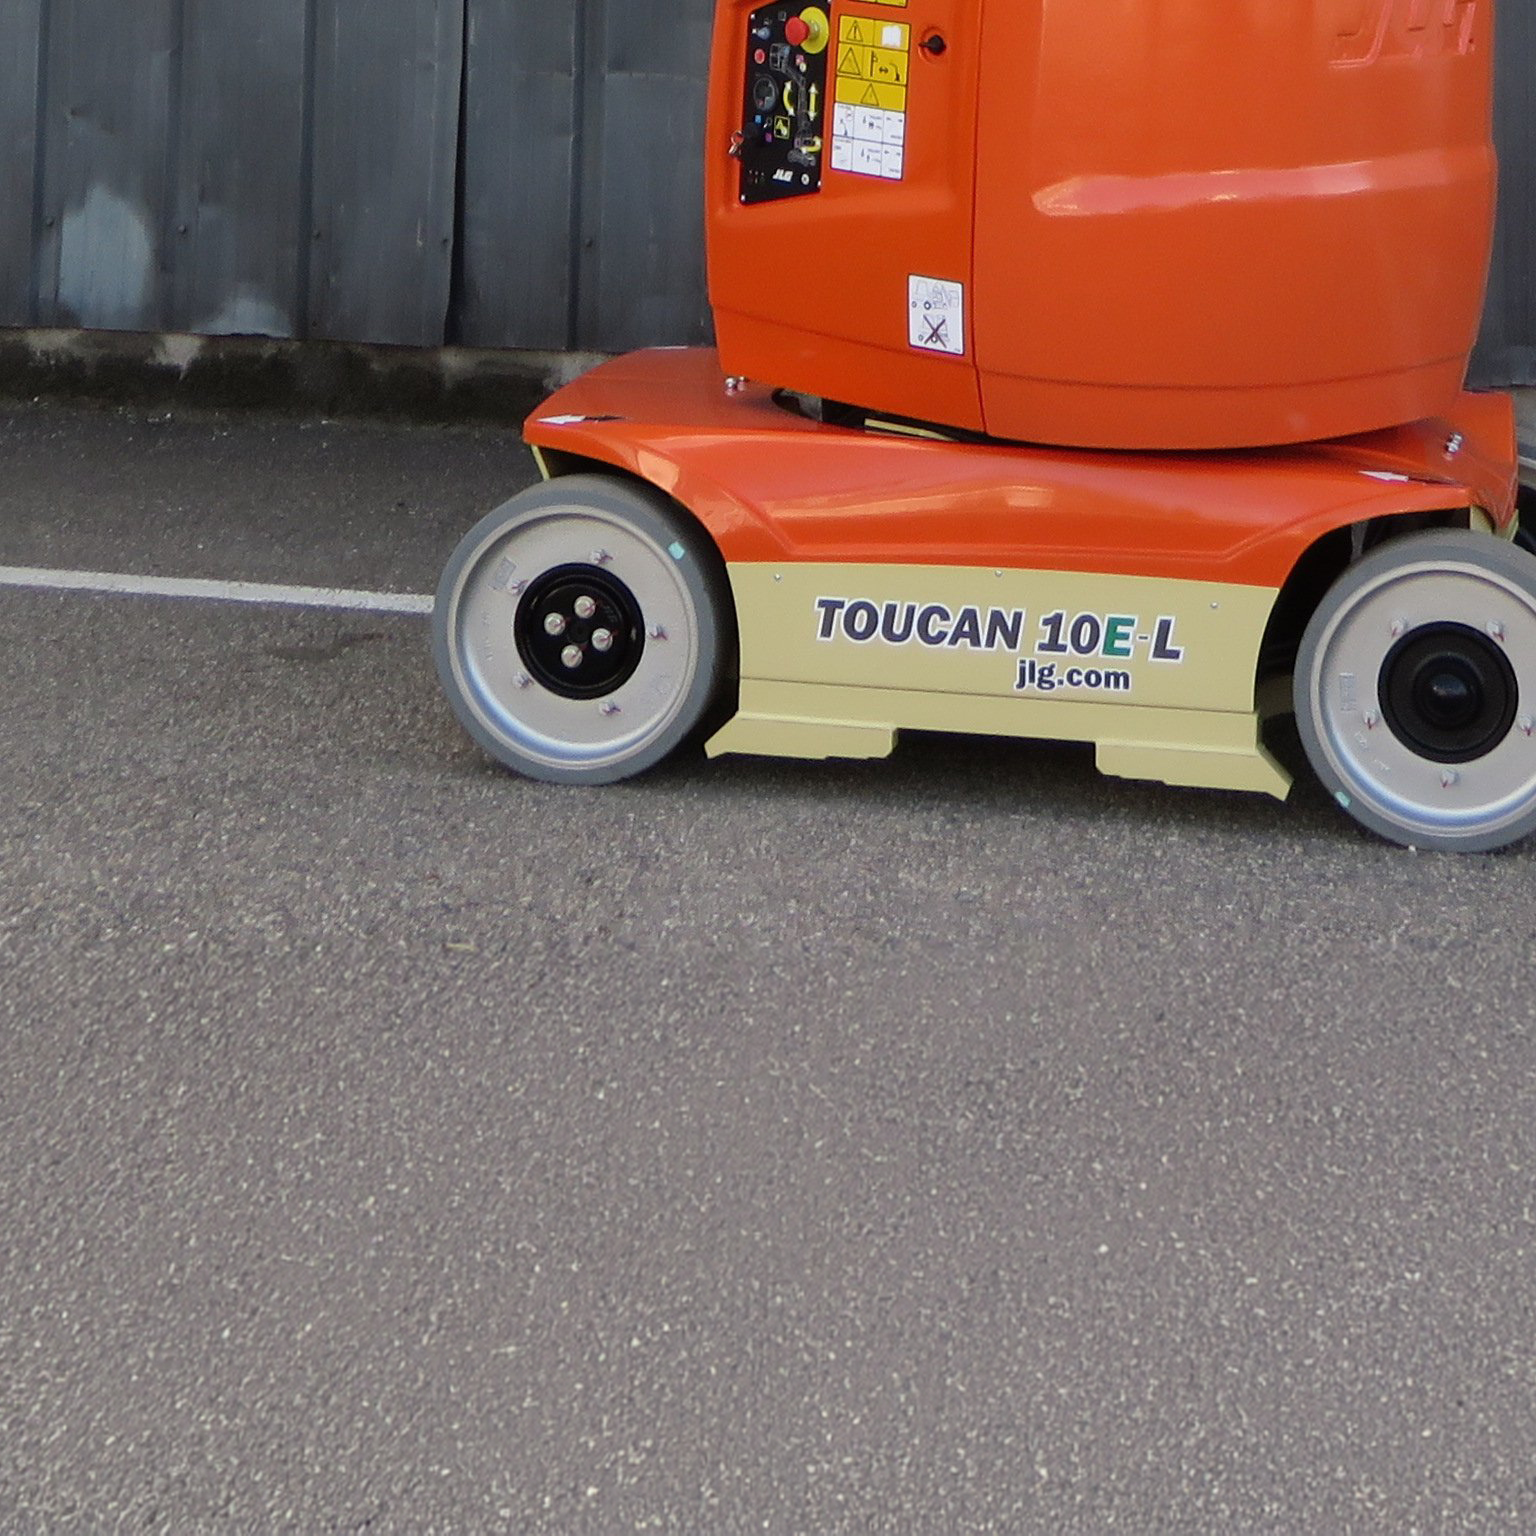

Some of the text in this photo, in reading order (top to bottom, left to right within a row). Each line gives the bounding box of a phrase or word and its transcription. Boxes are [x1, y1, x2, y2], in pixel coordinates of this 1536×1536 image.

[816, 598, 1182, 661] TOUCAN 10E-L
[1015, 659, 1131, 691] jlg.com
